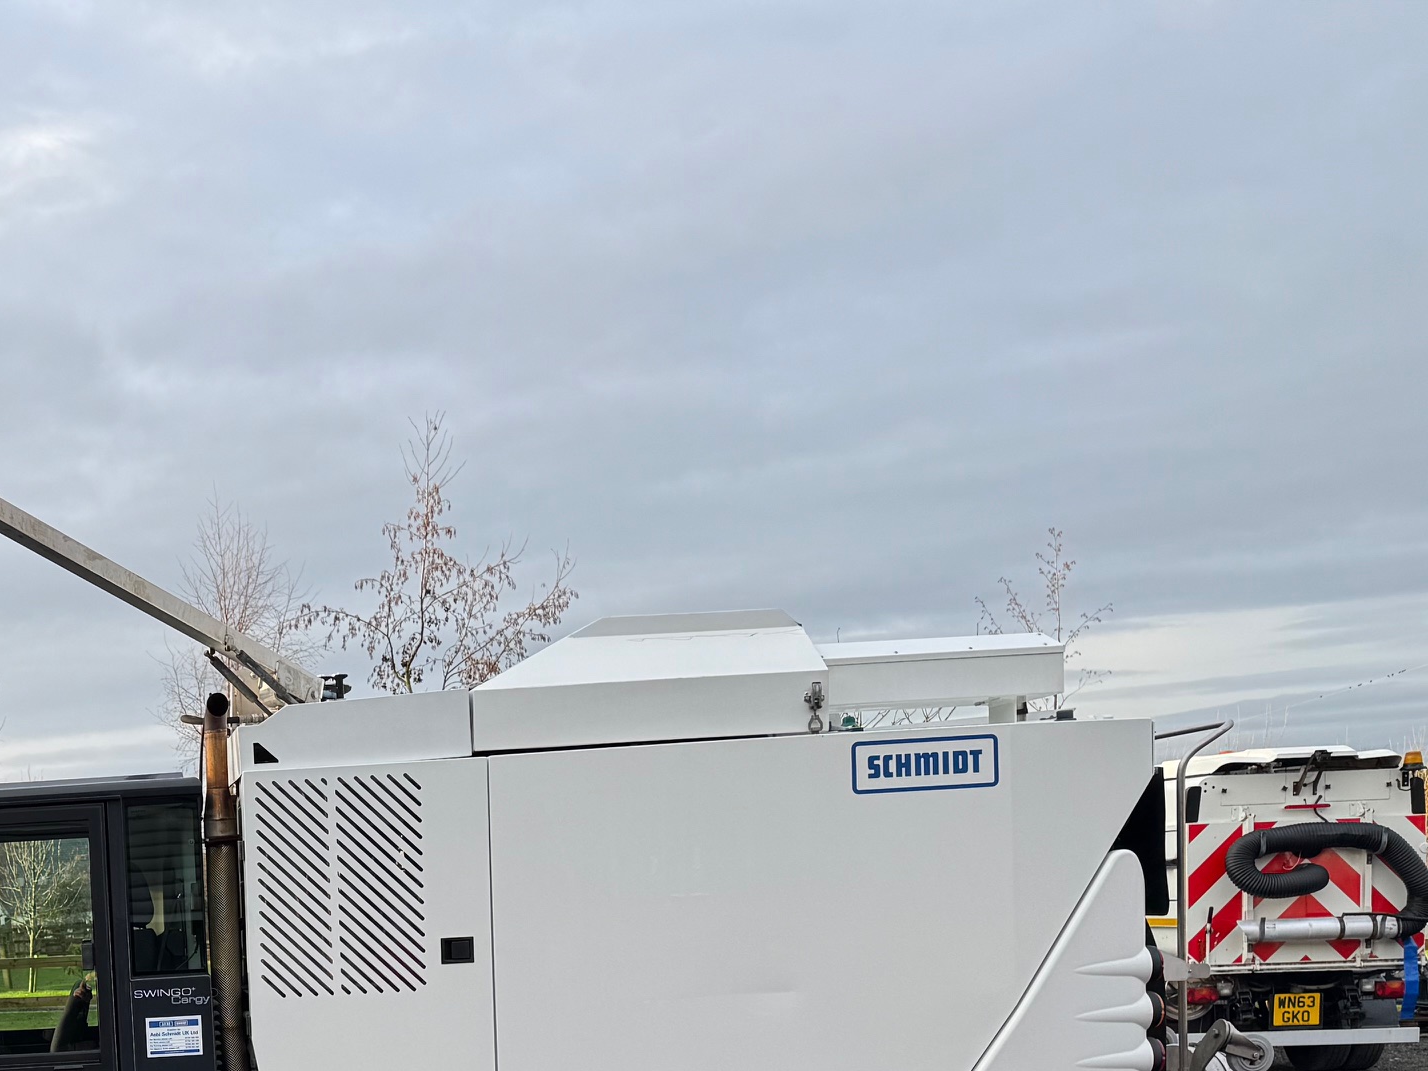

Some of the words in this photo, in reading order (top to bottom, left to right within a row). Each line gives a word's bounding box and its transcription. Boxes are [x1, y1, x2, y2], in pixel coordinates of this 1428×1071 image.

[867, 749, 983, 779] SCHMIDT
[171, 995, 211, 1005] Cargy
[1278, 995, 1316, 1009] WN63
[1282, 1010, 1310, 1023] GKO
